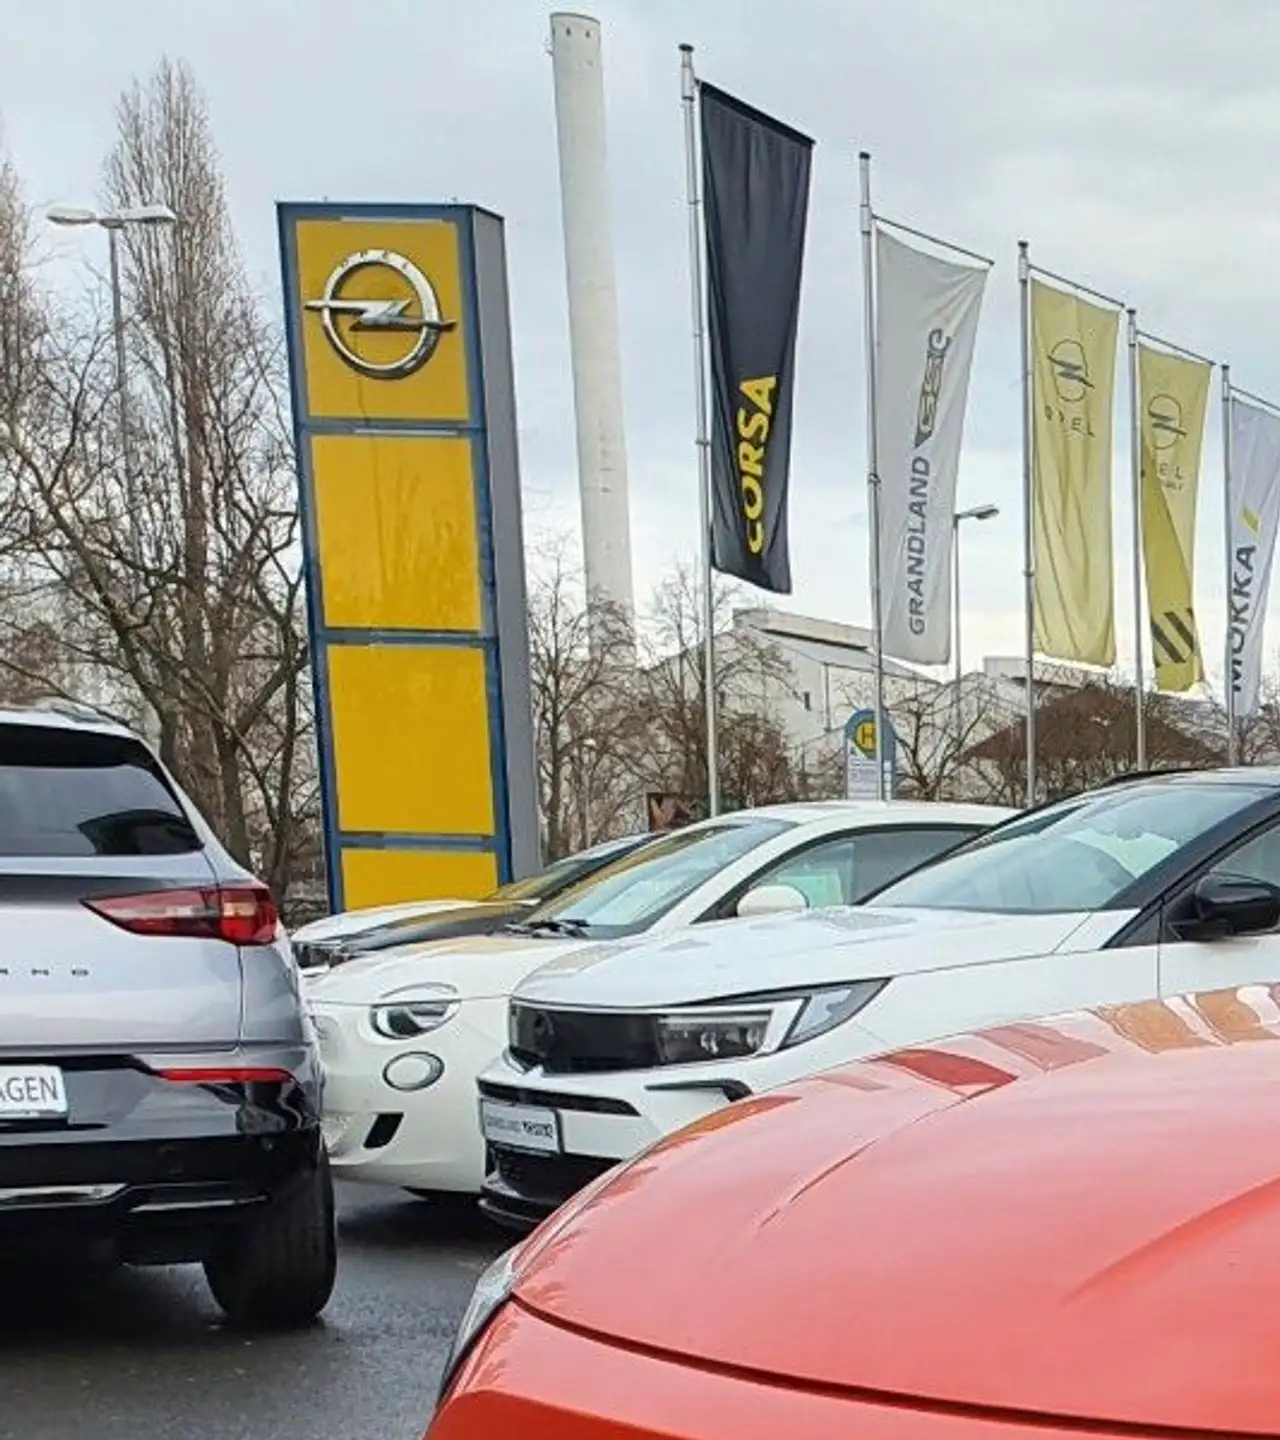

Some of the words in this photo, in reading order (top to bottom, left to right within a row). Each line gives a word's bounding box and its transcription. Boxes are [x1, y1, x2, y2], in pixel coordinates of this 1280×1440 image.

[737, 375, 776, 554] CORSA
[907, 456, 931, 636] GRANDLAND
[1229, 545, 1257, 692] MOKKA
